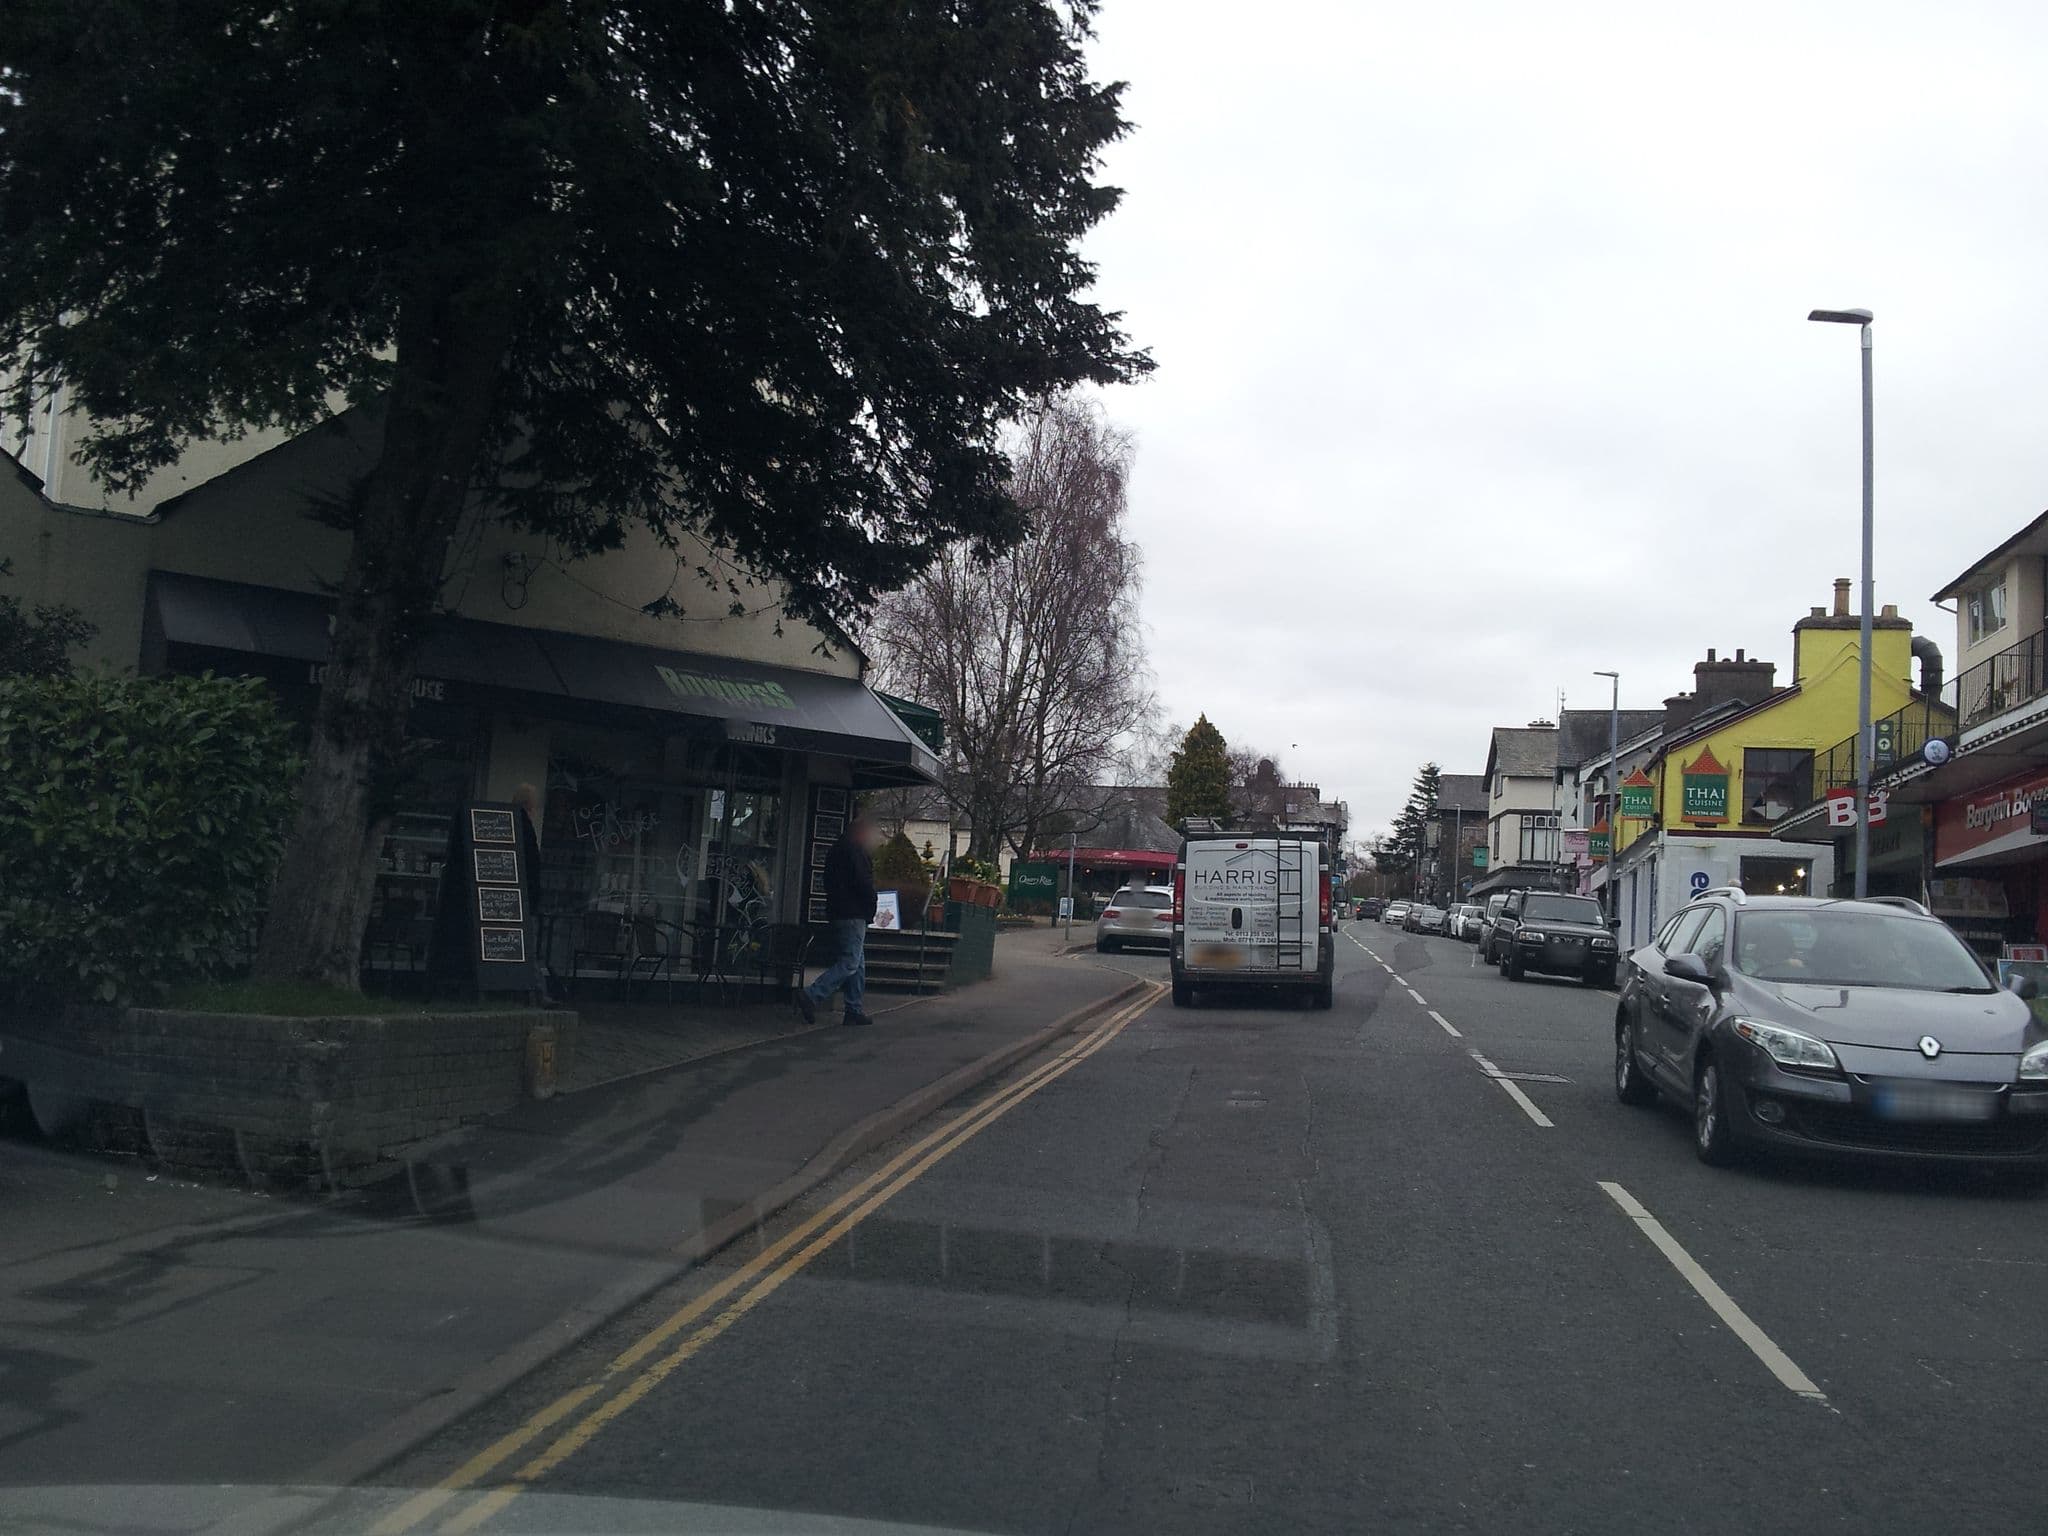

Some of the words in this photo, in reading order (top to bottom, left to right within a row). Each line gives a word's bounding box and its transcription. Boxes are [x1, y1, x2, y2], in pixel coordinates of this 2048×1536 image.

[1686, 788, 1725, 799] THAI
[1624, 796, 1652, 805] THAI
[1688, 799, 1724, 807] CUISINE
[1967, 792, 2010, 832] Bargain
[1194, 870, 1277, 885] HARRIS
